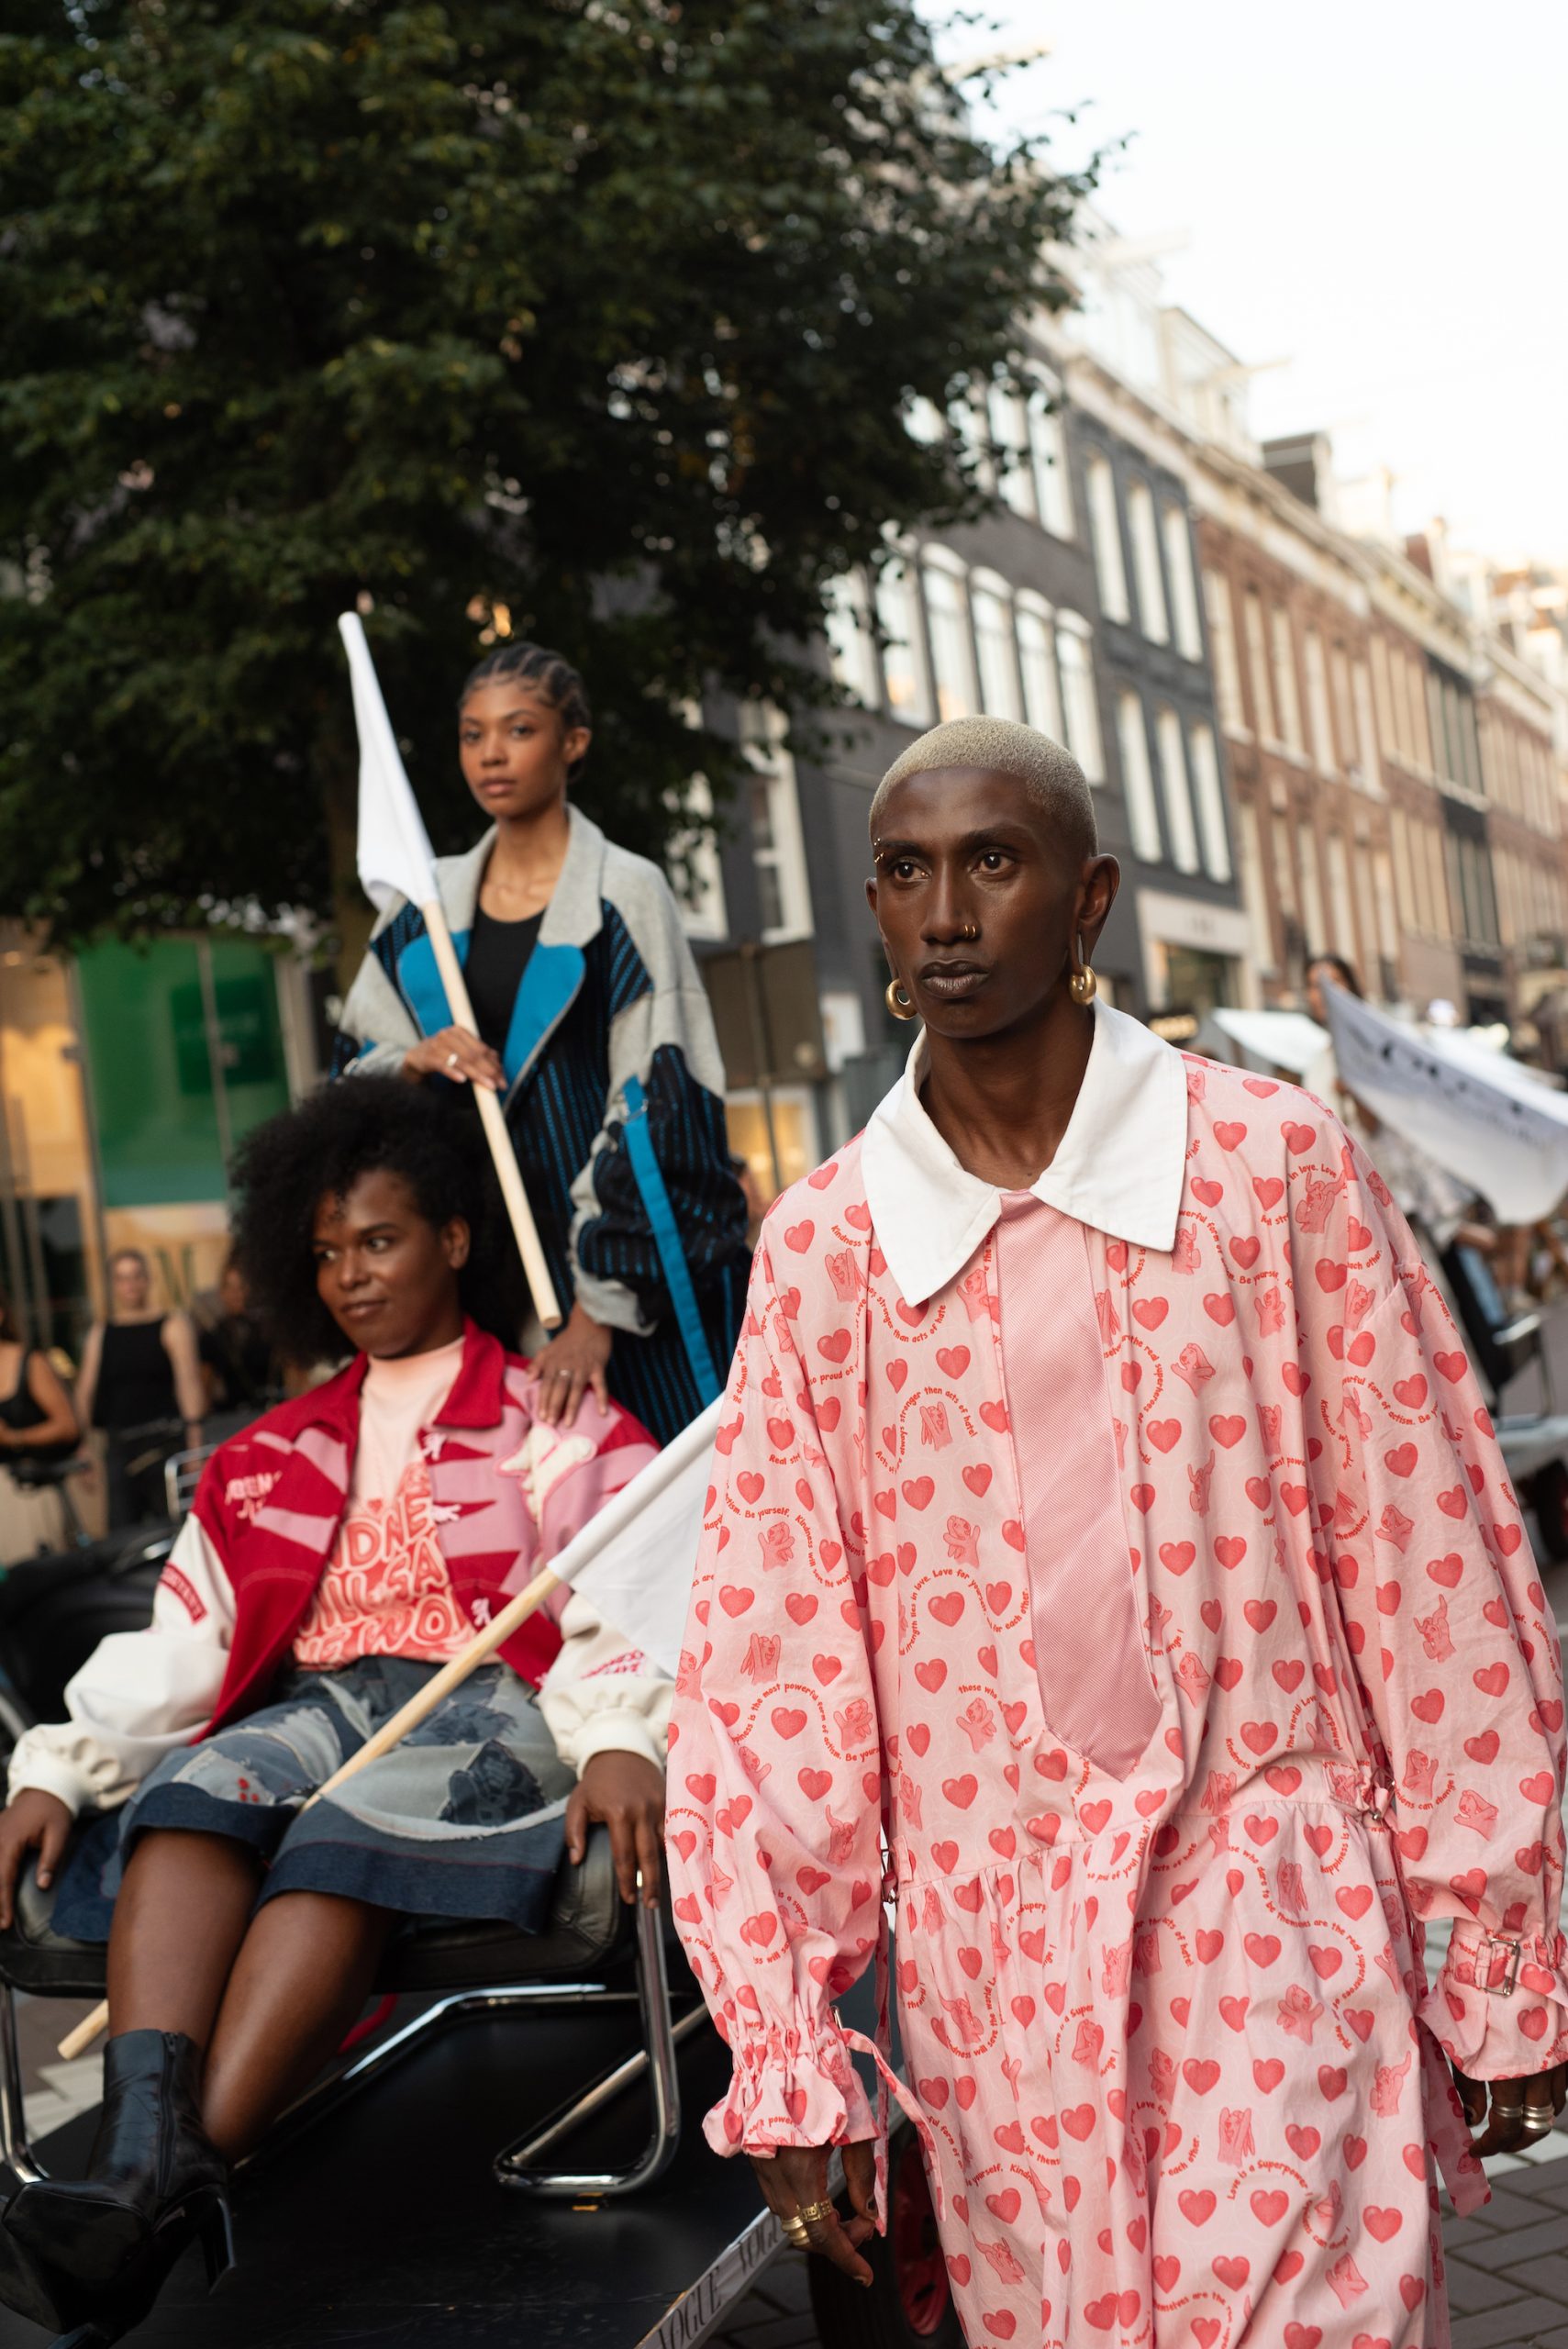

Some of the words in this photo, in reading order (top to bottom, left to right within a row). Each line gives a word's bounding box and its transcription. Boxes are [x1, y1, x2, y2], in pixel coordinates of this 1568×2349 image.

[830, 1224, 862, 1247] Kindness
[1240, 1275, 1251, 1285] Be
[877, 1296, 894, 1330] stronger
[893, 1329, 909, 1343] than
[912, 1331, 929, 1343] acts
[929, 1323, 939, 1334] of
[937, 1304, 947, 1323] hate
[819, 1371, 843, 1385] proud
[924, 1386, 943, 1395] then
[945, 1390, 959, 1404] acts
[899, 1392, 922, 1423] stronger
[959, 1403, 968, 1414] of
[1418, 1414, 1431, 1424] Be
[900, 1426, 908, 1455] always
[875, 1450, 888, 1467] Acts
[745, 1509, 755, 1519] Be
[757, 1508, 790, 1521] yourself.
[795, 1515, 814, 1549] Kindness
[807, 1552, 817, 1567] will
[932, 1568, 953, 1577] Love
[956, 1569, 970, 1580] for
[1005, 1615, 1023, 1630] each
[958, 1684, 982, 1695] those
[984, 1687, 998, 1699] who
[751, 1698, 763, 1711] the
[763, 1684, 781, 1698] most
[846, 1753, 857, 1762] Be
[1226, 1737, 1251, 1770] Kindness
[1243, 1850, 1259, 1864] who
[1314, 1920, 1329, 1928] are
[1331, 1923, 1346, 1936] the
[1342, 1954, 1366, 1998] superheroes
[973, 2046, 988, 2056] will
[1168, 2162, 1188, 2176] each
[1227, 2179, 1241, 2200] Love
